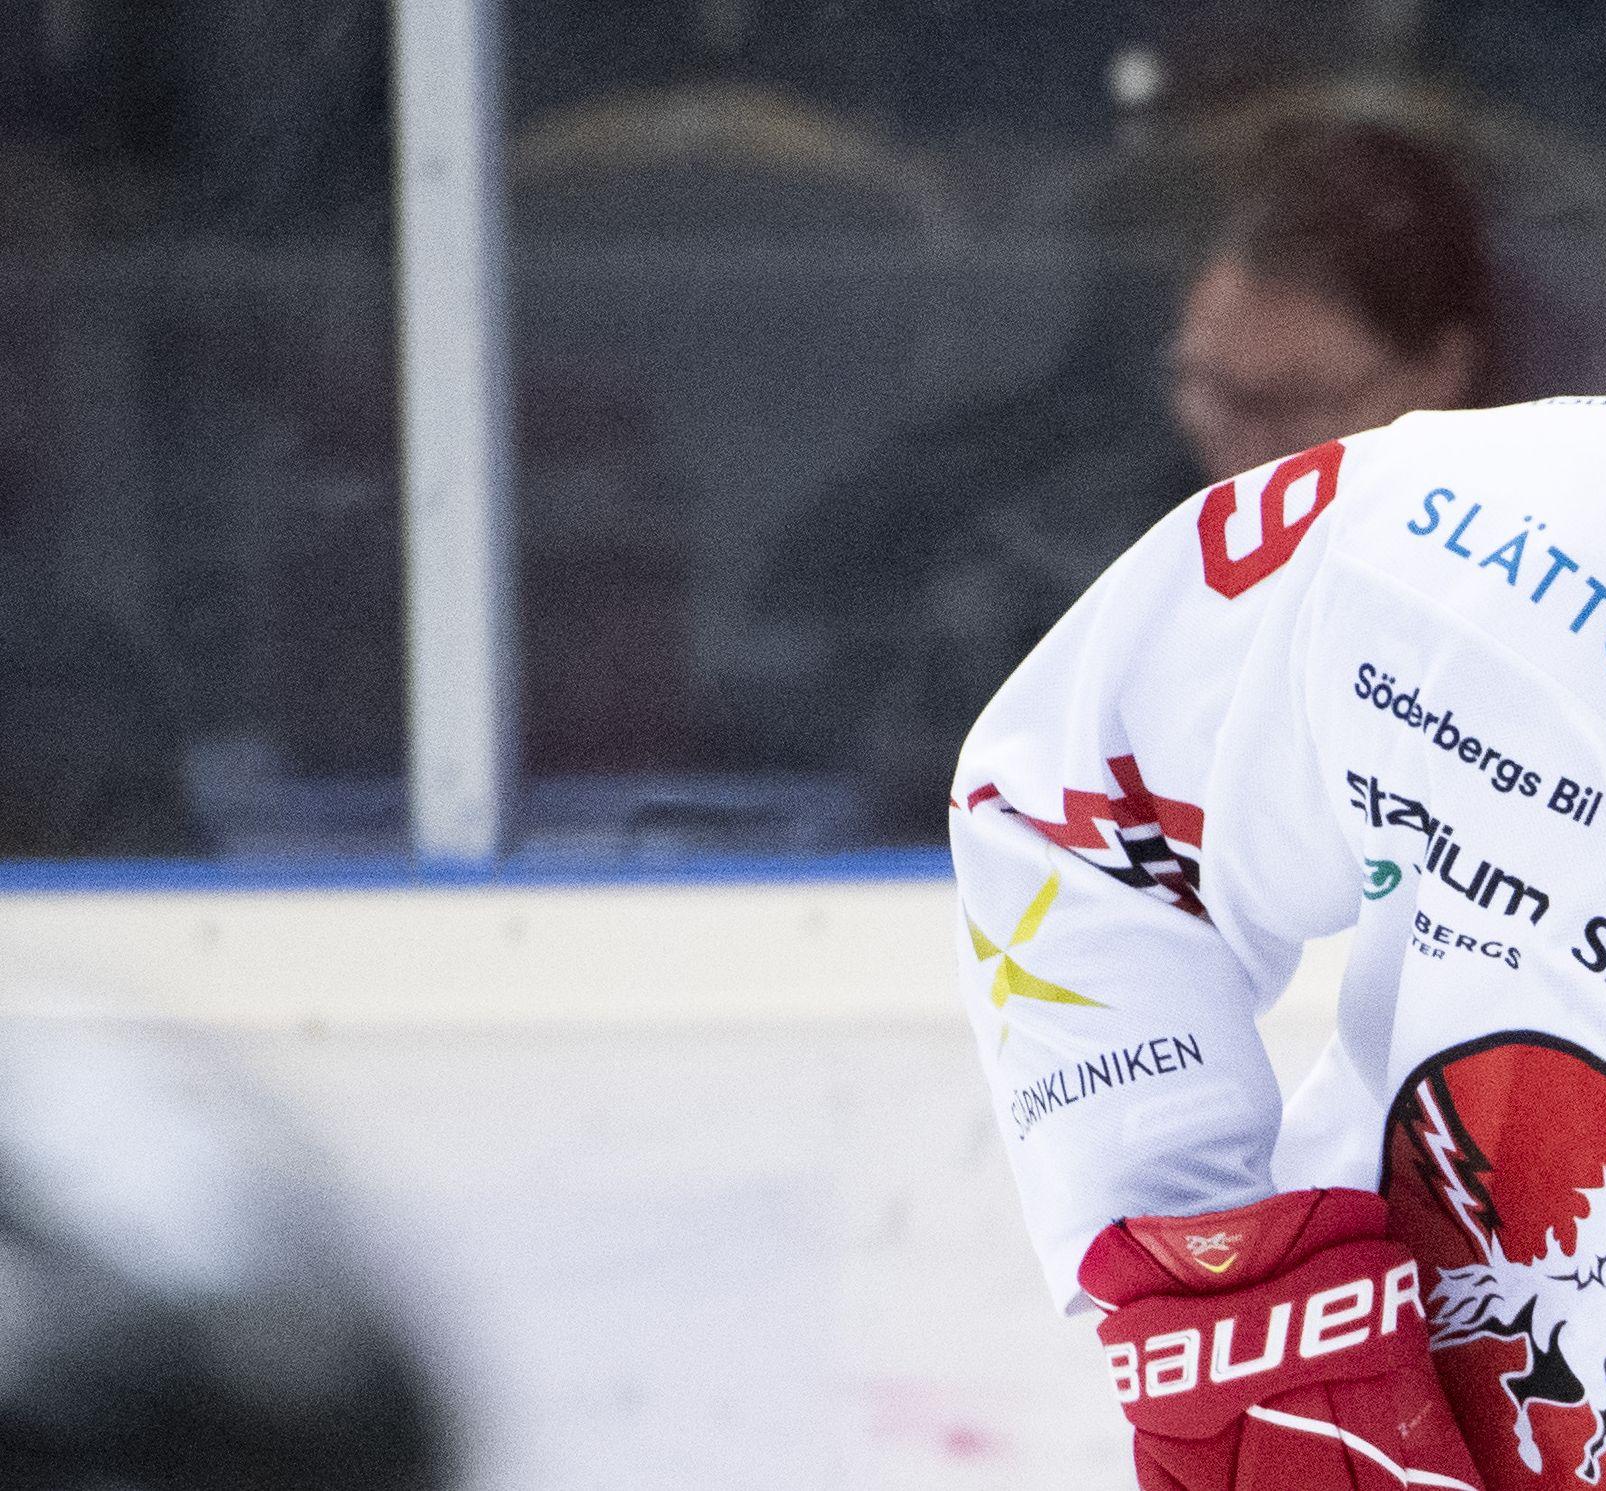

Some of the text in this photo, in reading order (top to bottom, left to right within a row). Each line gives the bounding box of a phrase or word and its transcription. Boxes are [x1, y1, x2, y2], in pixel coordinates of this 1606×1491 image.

[1354, 662, 1604, 827] Söderbergs Bil
[1413, 909, 1522, 970] BERGS
